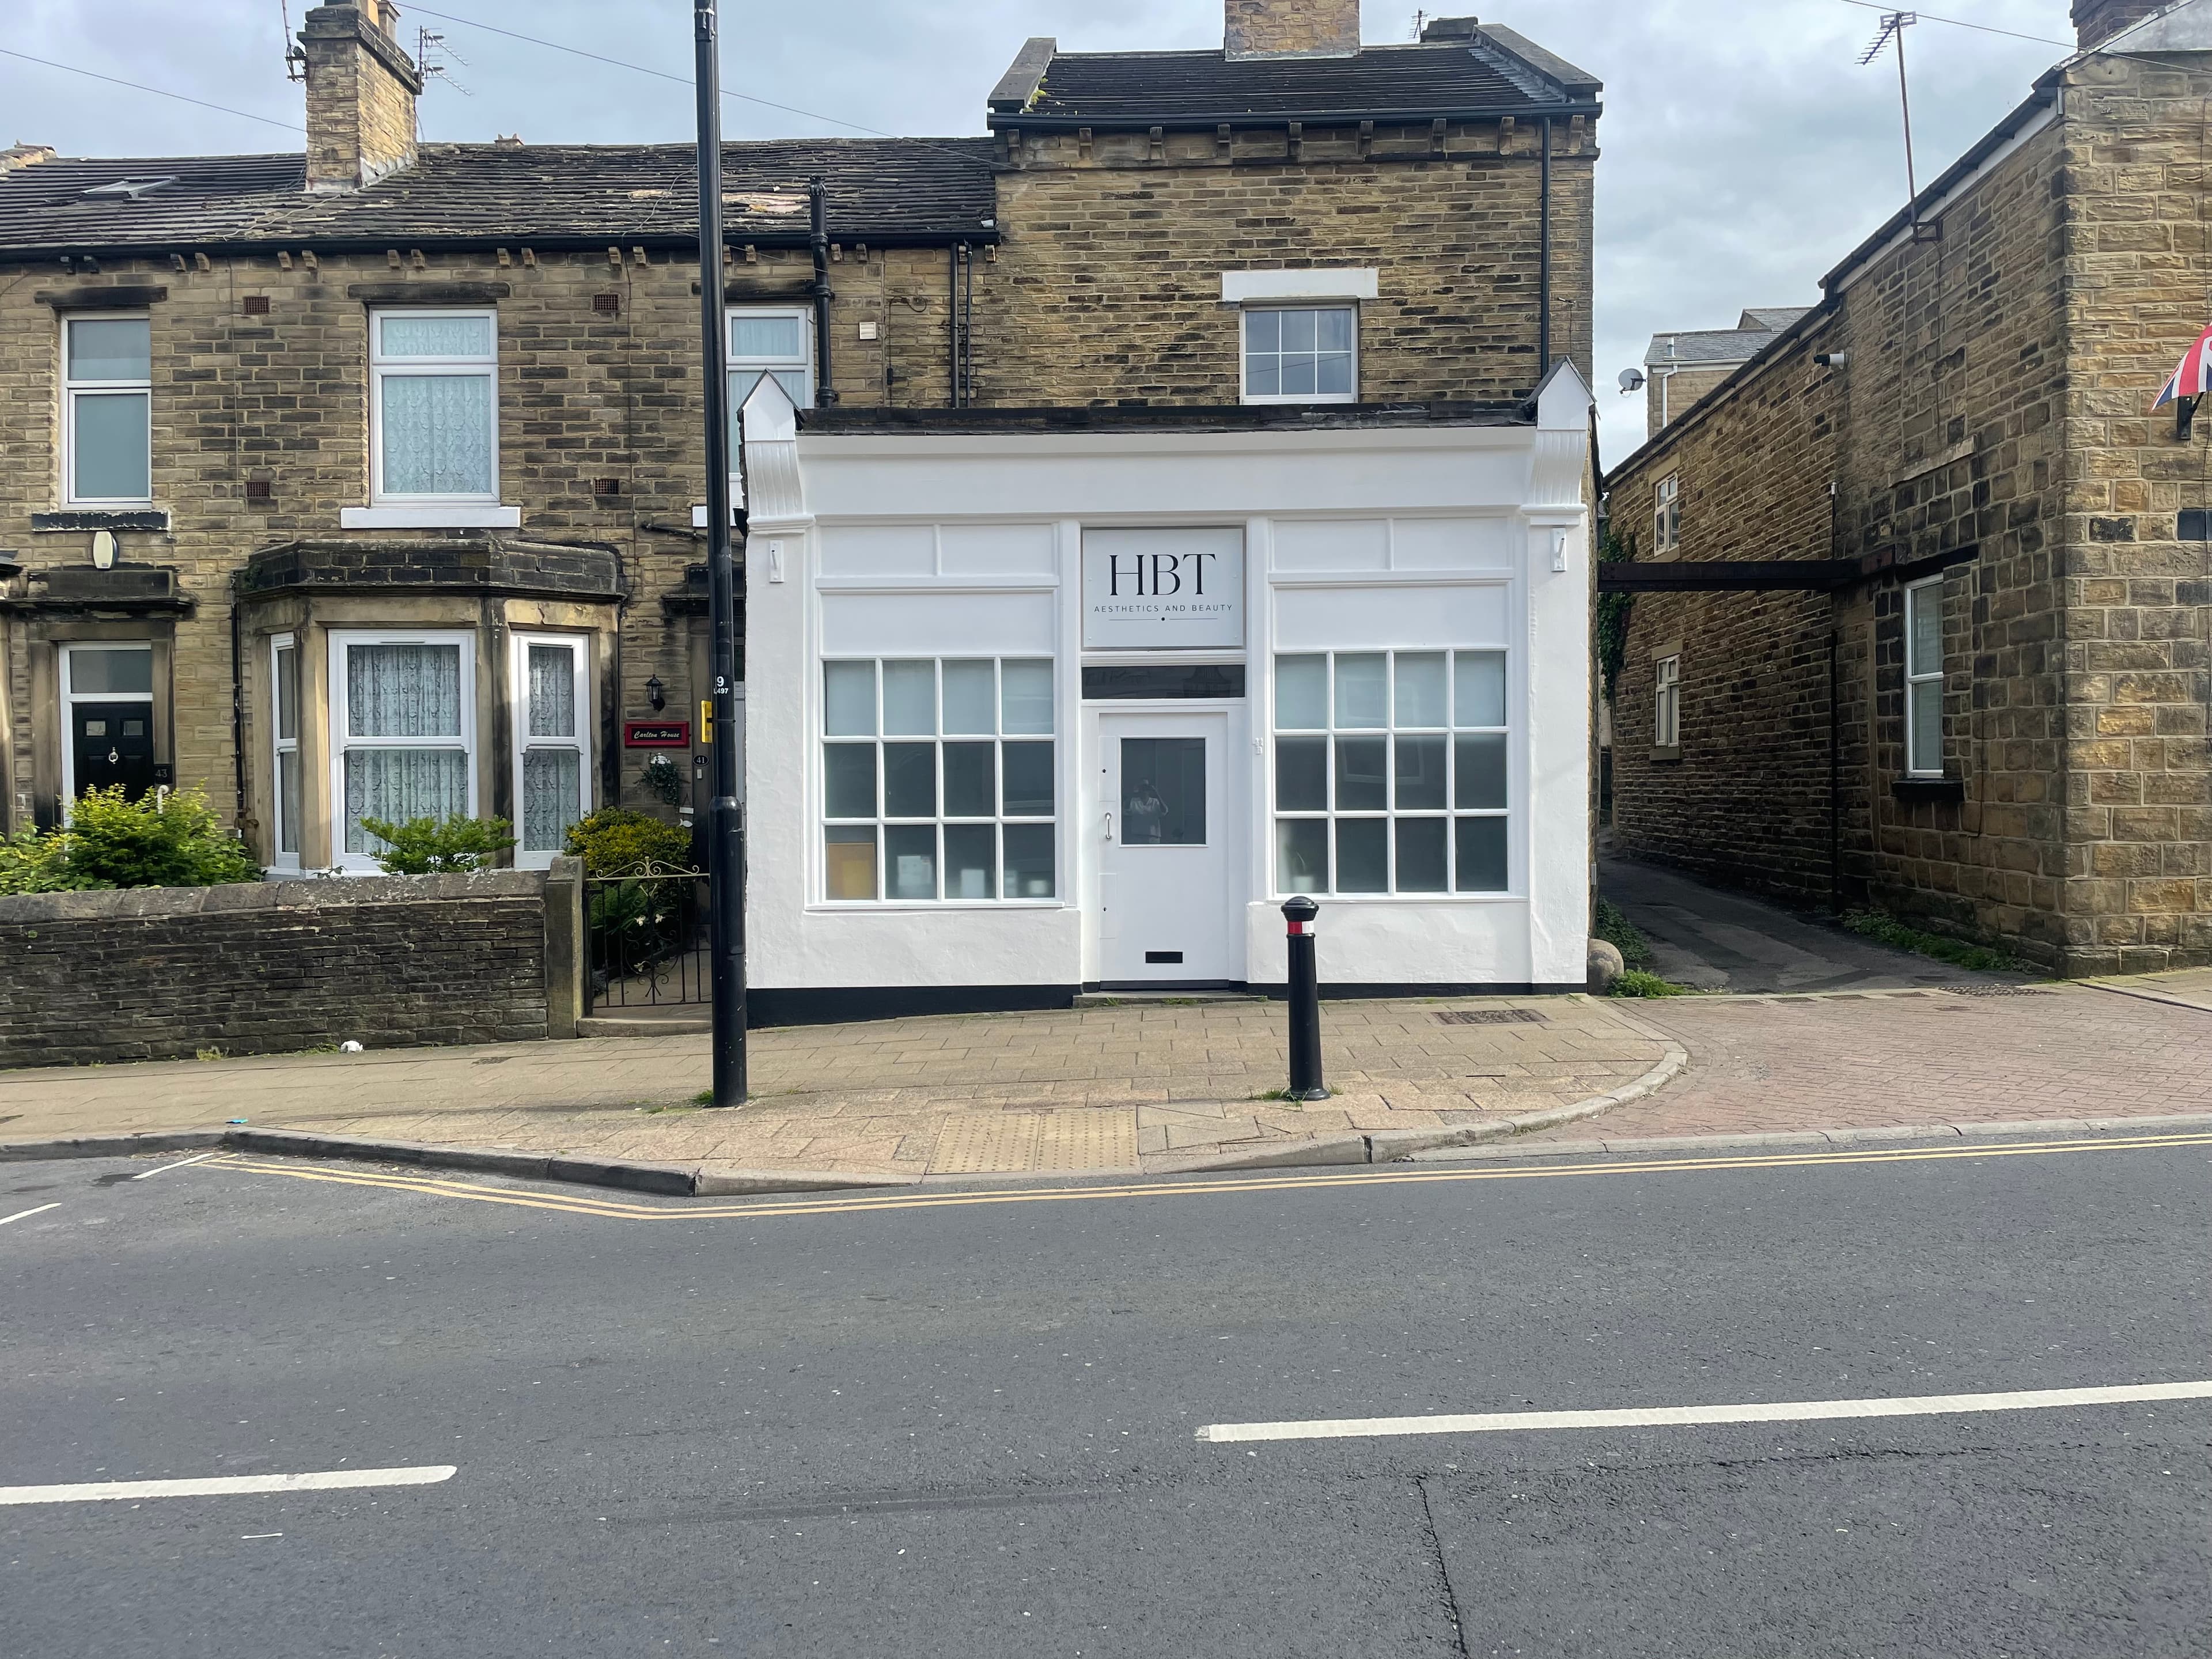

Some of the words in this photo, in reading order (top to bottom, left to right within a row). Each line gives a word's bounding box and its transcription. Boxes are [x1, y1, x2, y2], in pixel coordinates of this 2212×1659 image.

[1109, 554, 1216, 596] HBT
[717, 676, 724, 687] 9
[634, 730, 657, 739] Carlton
[155, 769, 167, 778] 43
